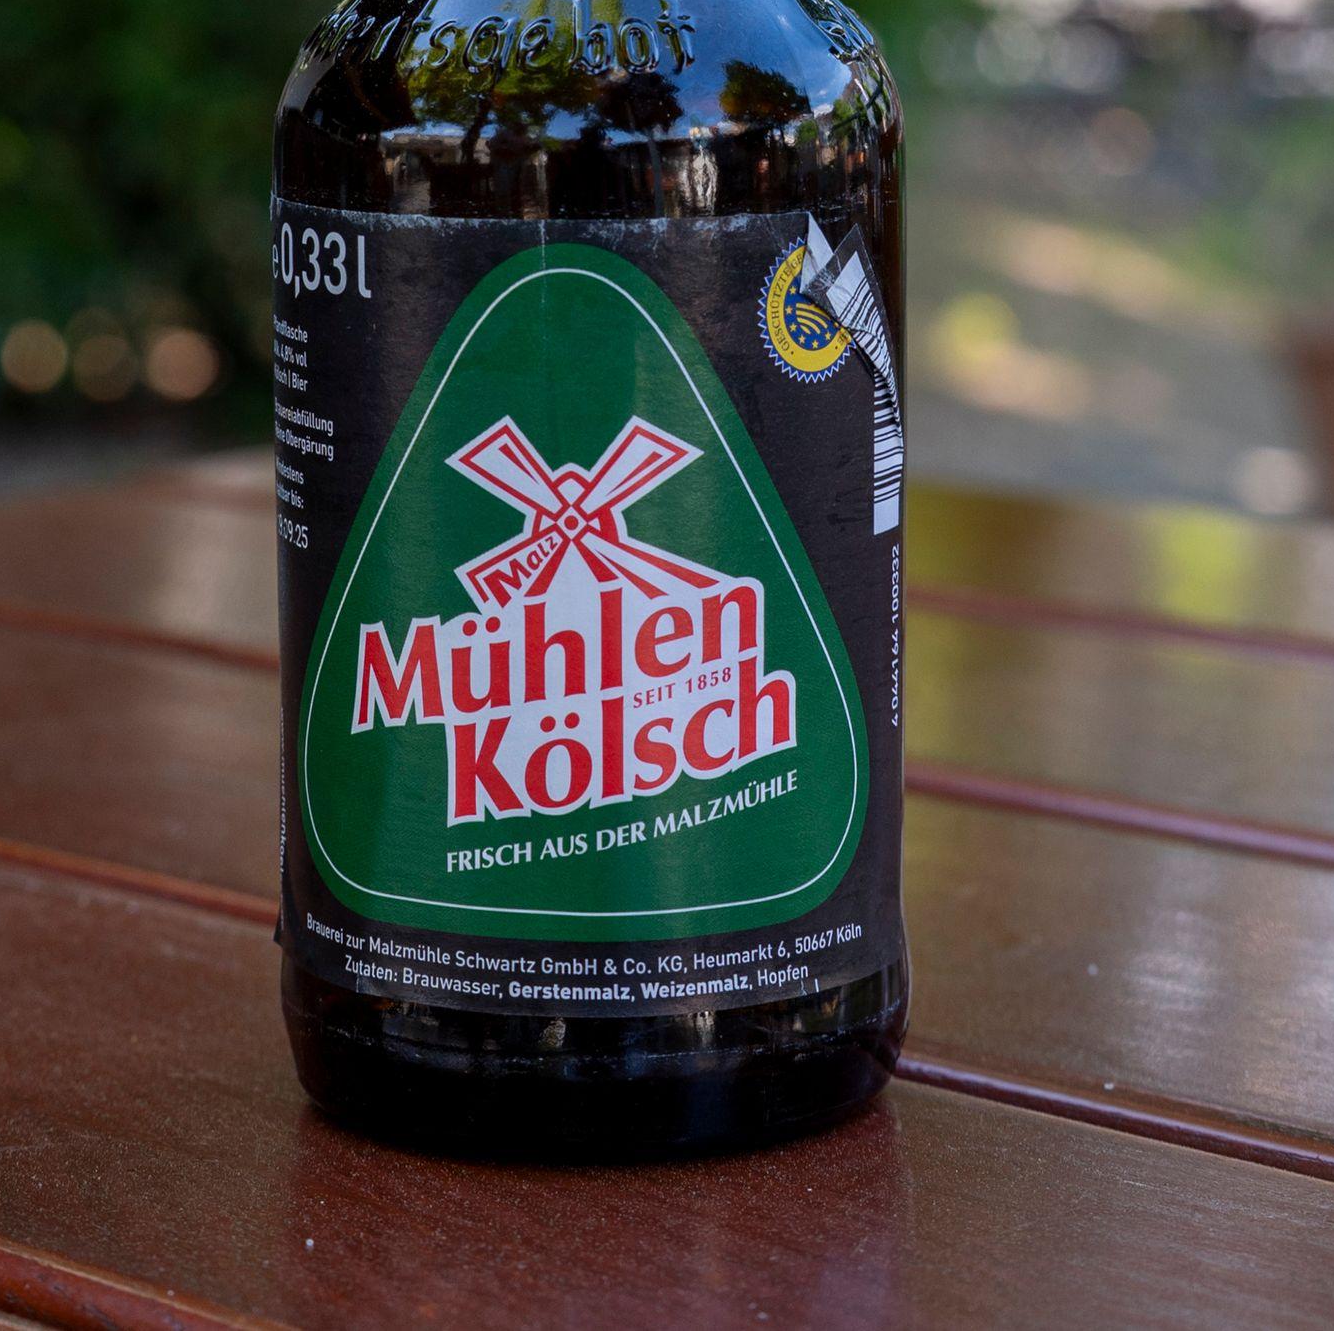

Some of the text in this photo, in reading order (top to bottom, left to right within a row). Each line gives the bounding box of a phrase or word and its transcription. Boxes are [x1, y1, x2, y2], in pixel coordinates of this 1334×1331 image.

[281, 222, 348, 299] 0,33
[357, 235, 372, 299] l
[291, 372, 309, 392] Bier
[295, 350, 308, 368] vol
[285, 428, 334, 462] Obergärung
[290, 490, 304, 509] bis:
[482, 535, 559, 608] Malz
[357, 584, 758, 726] Mühlen
[633, 667, 731, 709] SEIT 1858
[453, 655, 791, 819] Kölsch
[446, 768, 798, 873] FRISCH AUS DER MALZMÜHLE
[306, 912, 863, 975] Brauerei zur Malzmühle Schwartz GmbH & Co. KG, Heumarkt 6, 50667 Köln
[344, 954, 809, 1002] Zutaten: Brauwasser, Gerstenmalz, Weizenmalz, Hopfen
